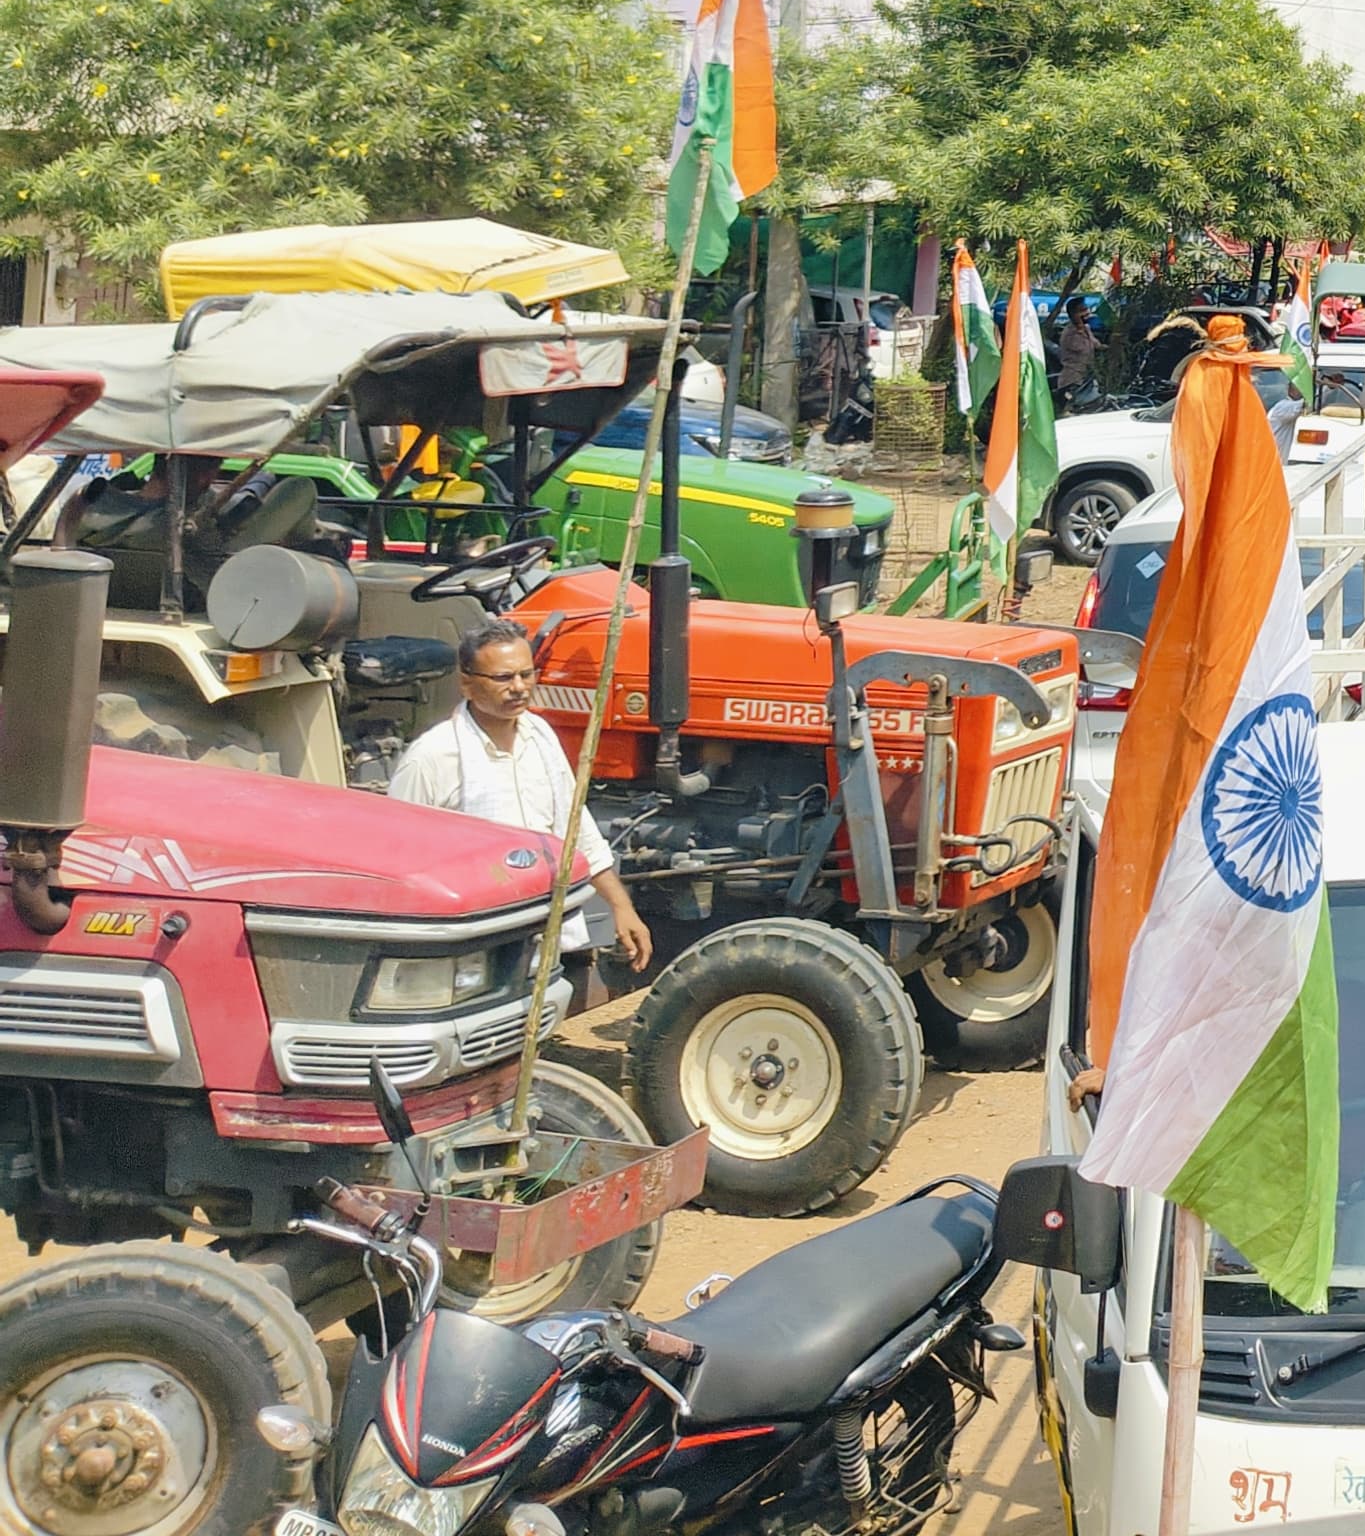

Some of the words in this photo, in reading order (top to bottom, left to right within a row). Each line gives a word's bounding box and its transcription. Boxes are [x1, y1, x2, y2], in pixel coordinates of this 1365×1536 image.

[749, 512, 785, 527] 5405
[84, 911, 145, 936] DLX
[421, 1433, 467, 1457] HONDA
